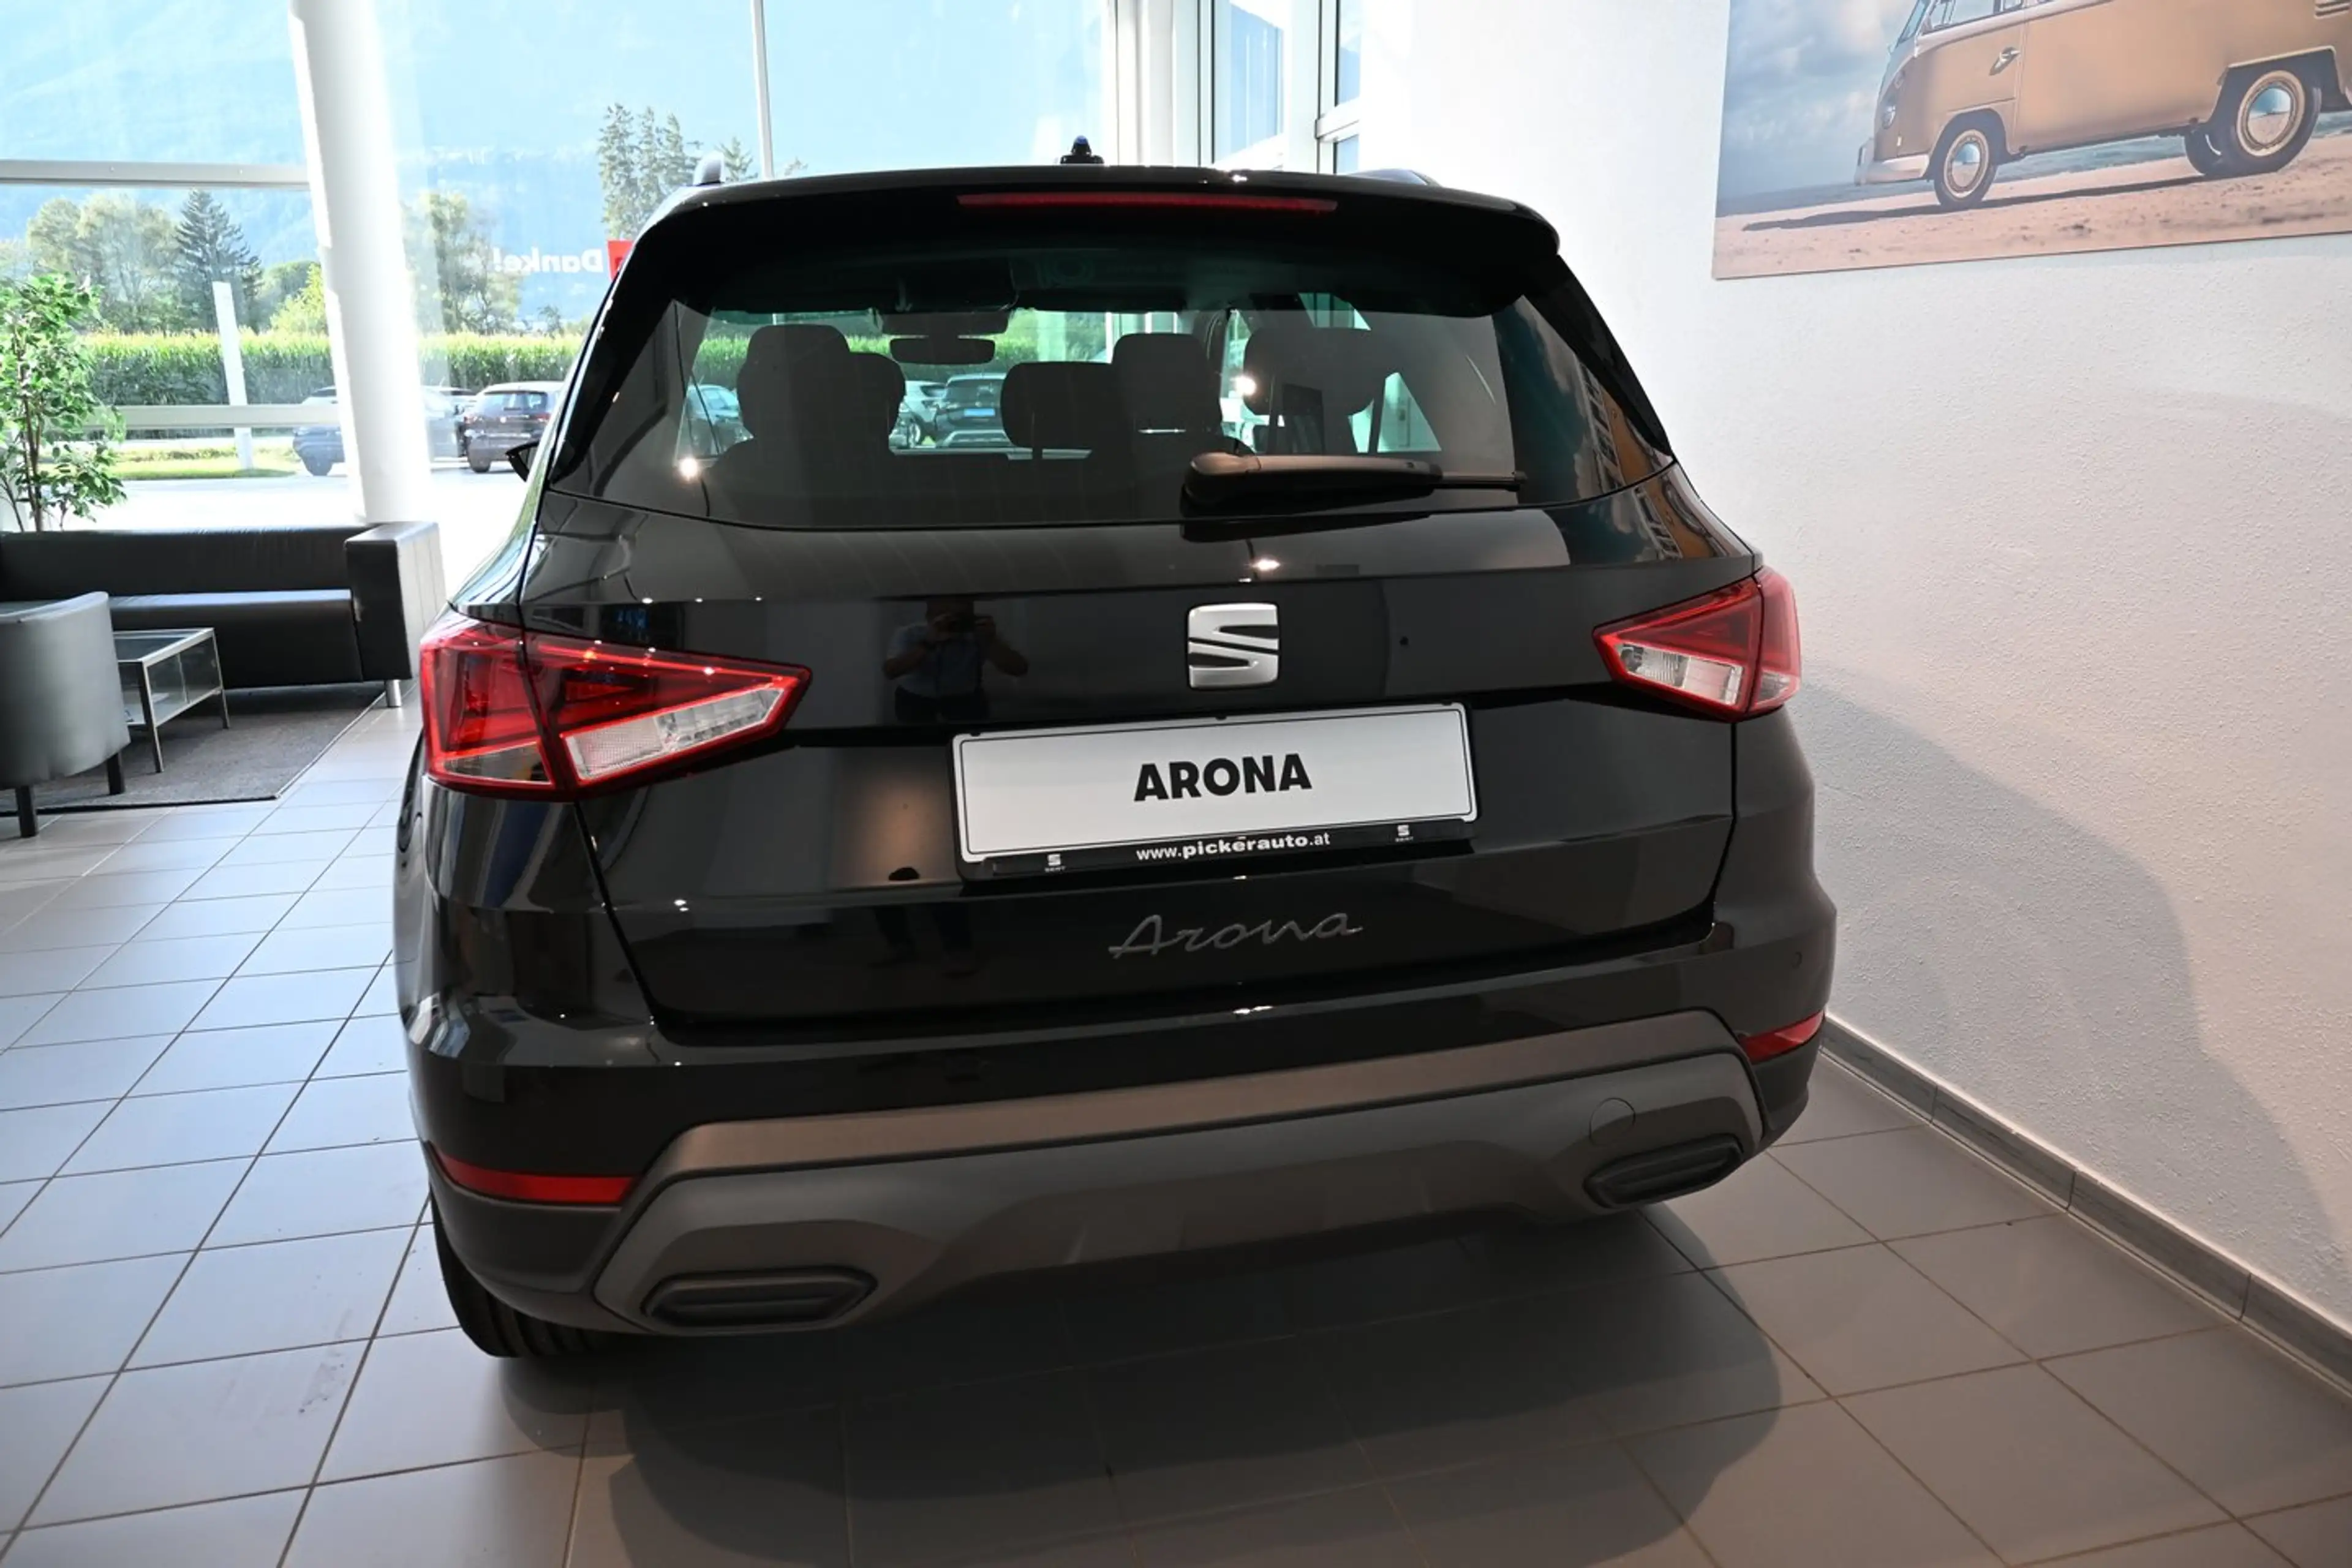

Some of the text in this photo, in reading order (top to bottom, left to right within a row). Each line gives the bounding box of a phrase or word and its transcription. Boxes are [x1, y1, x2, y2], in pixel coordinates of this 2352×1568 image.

[1133, 753, 1313, 802] ARONA
[1136, 832, 1331, 861] www.pickerauto.at
[1108, 912, 1364, 959] Arona
